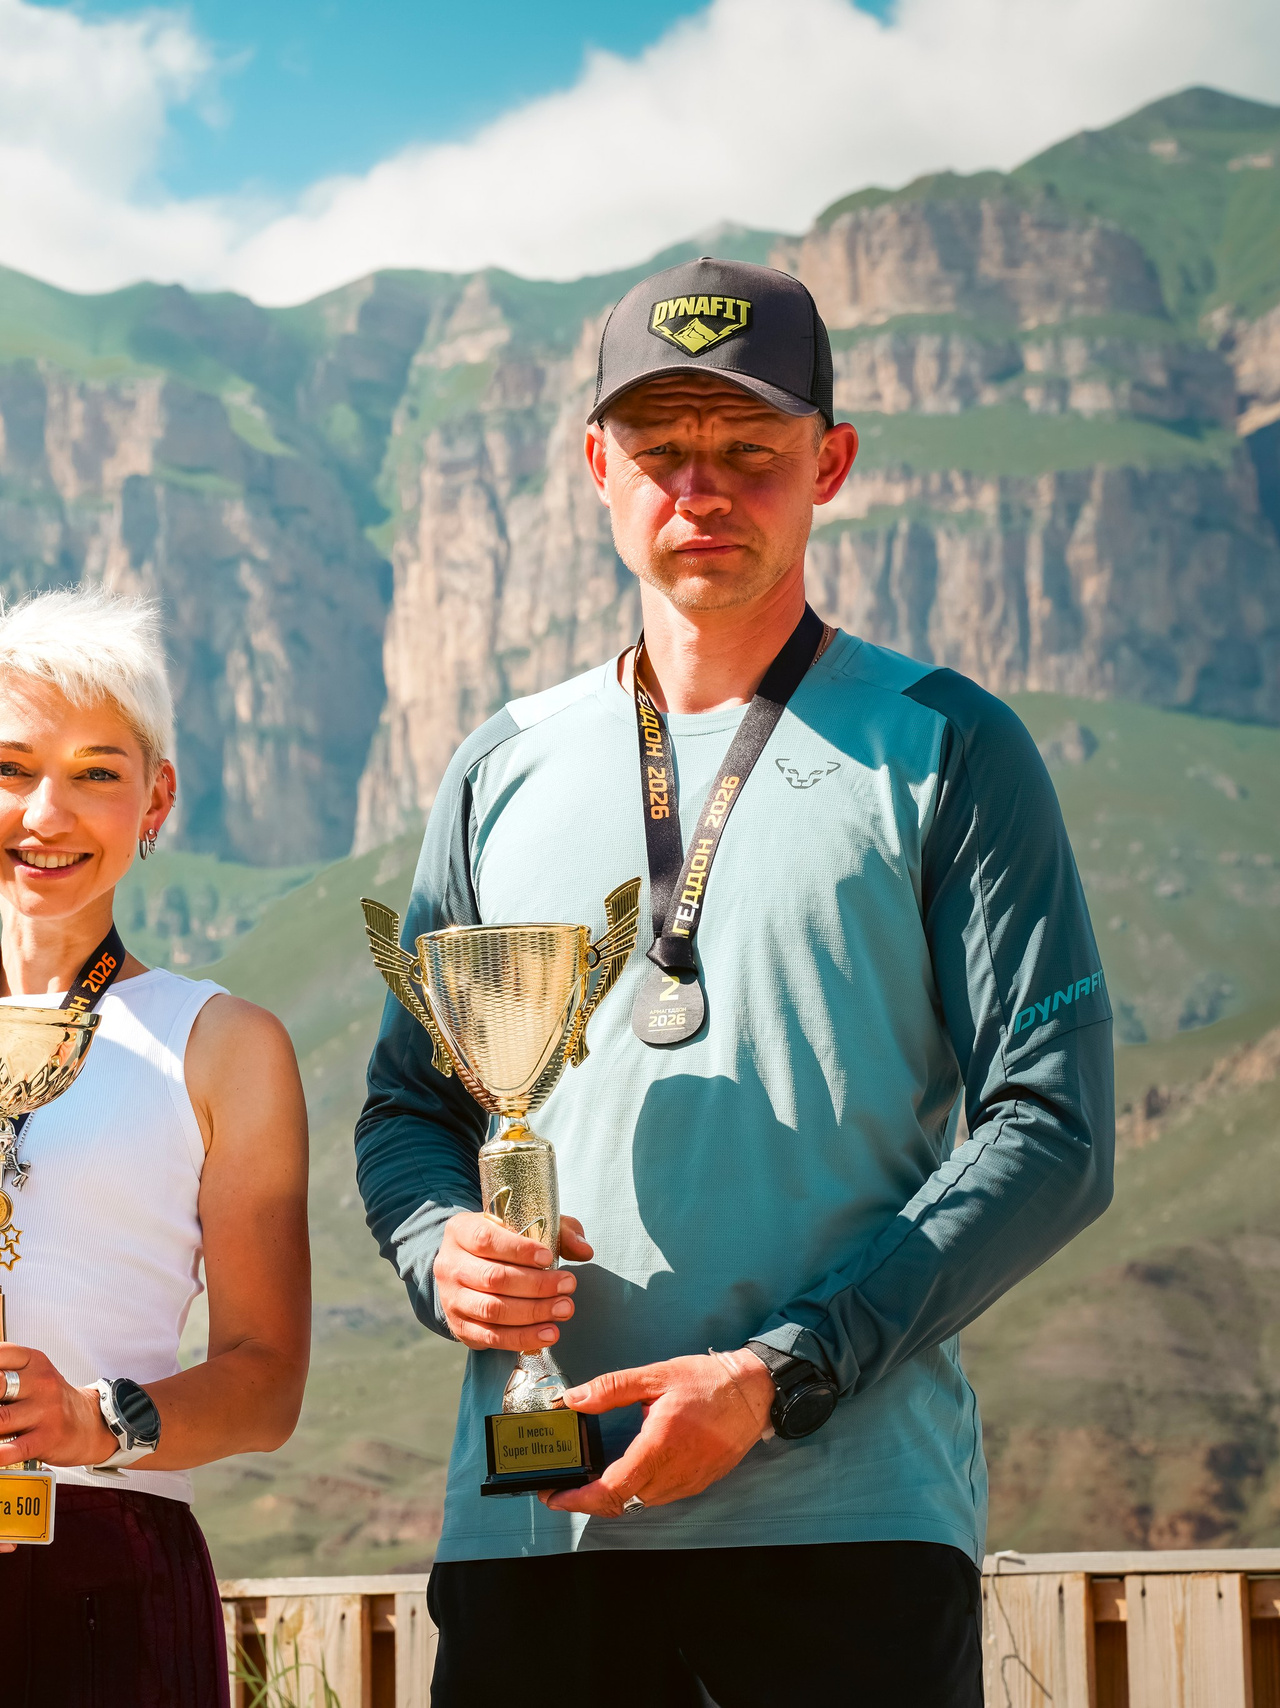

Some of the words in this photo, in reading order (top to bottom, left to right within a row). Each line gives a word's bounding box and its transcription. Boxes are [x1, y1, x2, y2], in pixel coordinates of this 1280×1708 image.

[652, 296, 751, 327] DYNAFIT
[637, 680, 663, 757] ЕДДОН
[647, 765, 670, 820] 2026
[671, 838, 714, 939] ГЕДДОН
[704, 775, 741, 829] 2026
[81, 951, 117, 993] 2026
[660, 975, 680, 1001] 2
[648, 1013, 686, 1027] 2026
[518, 1426, 524, 1439] II
[526, 1427, 554, 1437] место
[503, 1445, 528, 1459] Super
[531, 1442, 554, 1455] Ultra
[556, 1440, 572, 1453] 500
[16, 1496, 41, 1517] 500
